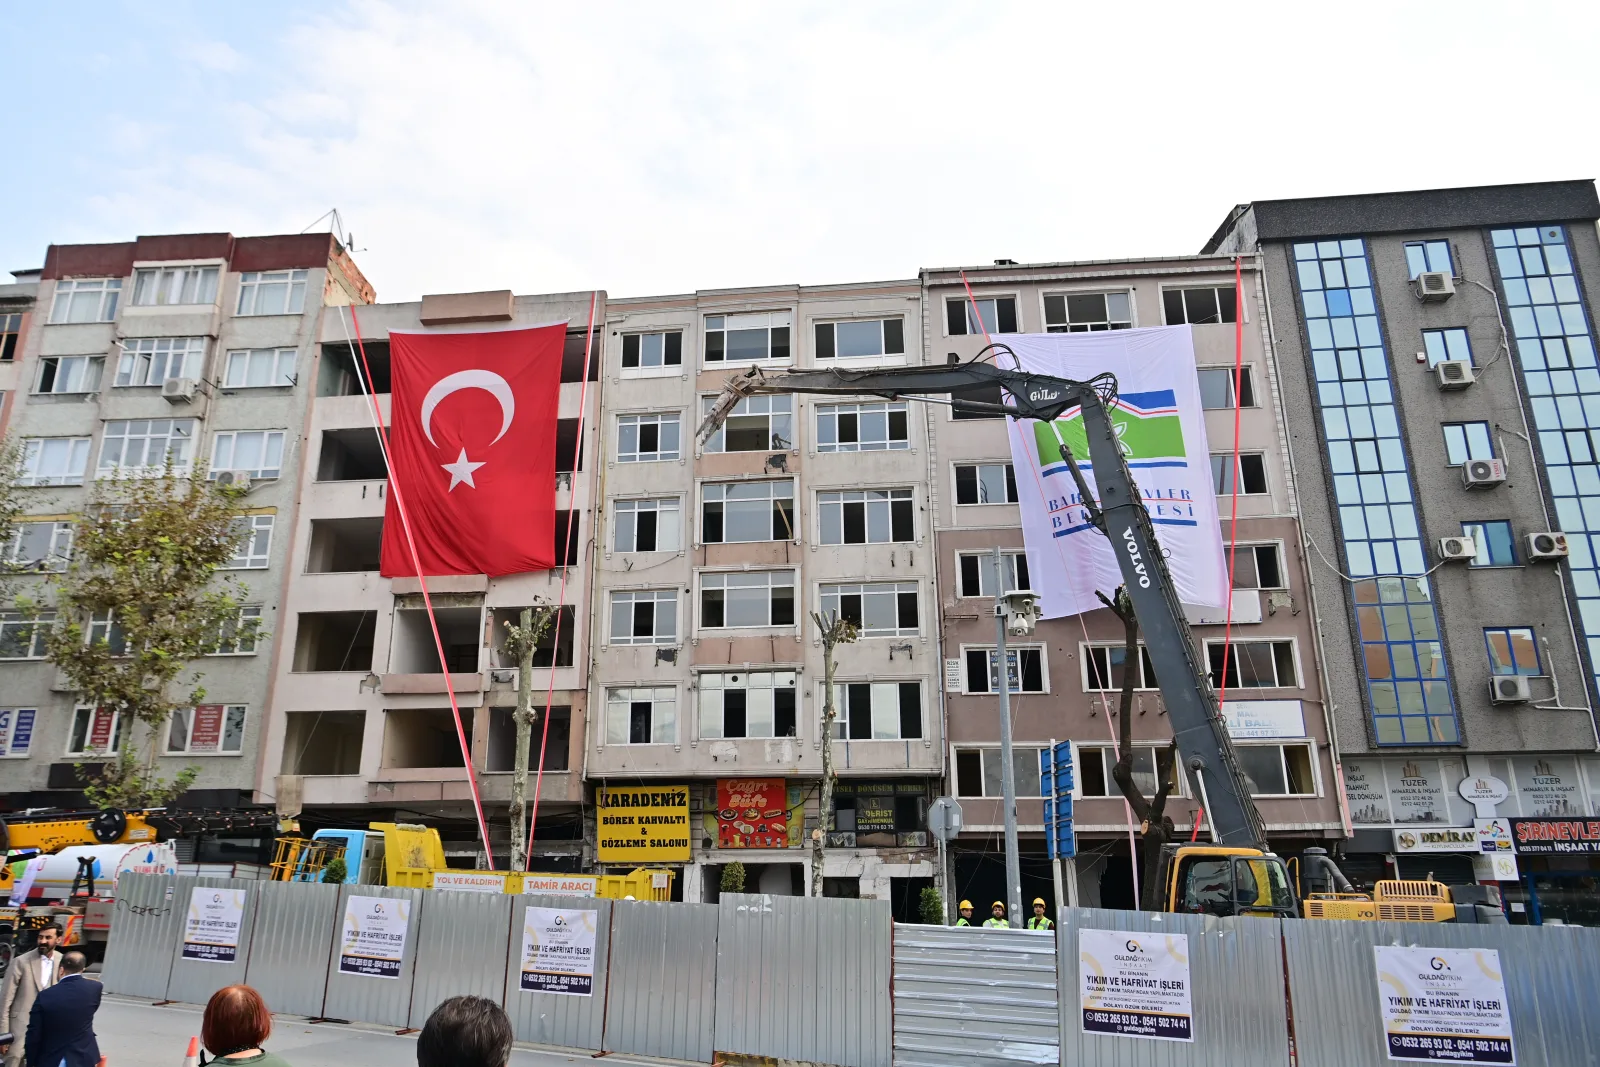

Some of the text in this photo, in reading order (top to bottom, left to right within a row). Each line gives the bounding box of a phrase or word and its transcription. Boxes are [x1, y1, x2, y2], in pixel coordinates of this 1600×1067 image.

[1122, 526, 1150, 588] VOLVO
[600, 789, 686, 808] KARADENİZ
[729, 794, 767, 808] Büfe
[602, 815, 686, 825] BÖREK KAHVALTI
[602, 838, 688, 848] GÖZLEME SALONU
[1420, 830, 1475, 843] DEMİRAY
[1554, 841, 1589, 852] İNŞAAT
[528, 879, 592, 891] TAMİR ARACI
[549, 945, 573, 954] HAFRİYAT
[575, 946, 591, 955] İŞLERİ
[1086, 975, 1184, 991] YIKIM VE HAFRİYAT İŞLERİ
[1388, 997, 1501, 1011] YIKIM VE HAFRİYAT İŞLERİ
[1094, 1013, 1108, 1022] 0532
[1110, 1014, 1120, 1023] 265
[1122, 1015, 1129, 1024] 93
[1130, 1016, 1138, 1025] 02
[1142, 1016, 1156, 1026] 0541
[1158, 1017, 1169, 1027] 502
[1171, 1018, 1179, 1028] 74
[1179, 1019, 1187, 1029] 41
[1402, 1037, 1418, 1047] 0532
[1420, 1038, 1432, 1048] 265
[1433, 1039, 1442, 1049] 93
[1444, 1039, 1452, 1049] 02
[1457, 1040, 1474, 1050] 0541
[1476, 1041, 1489, 1051] 502
[1490, 1042, 1499, 1052] 74
[1500, 1042, 1508, 1052] 41
